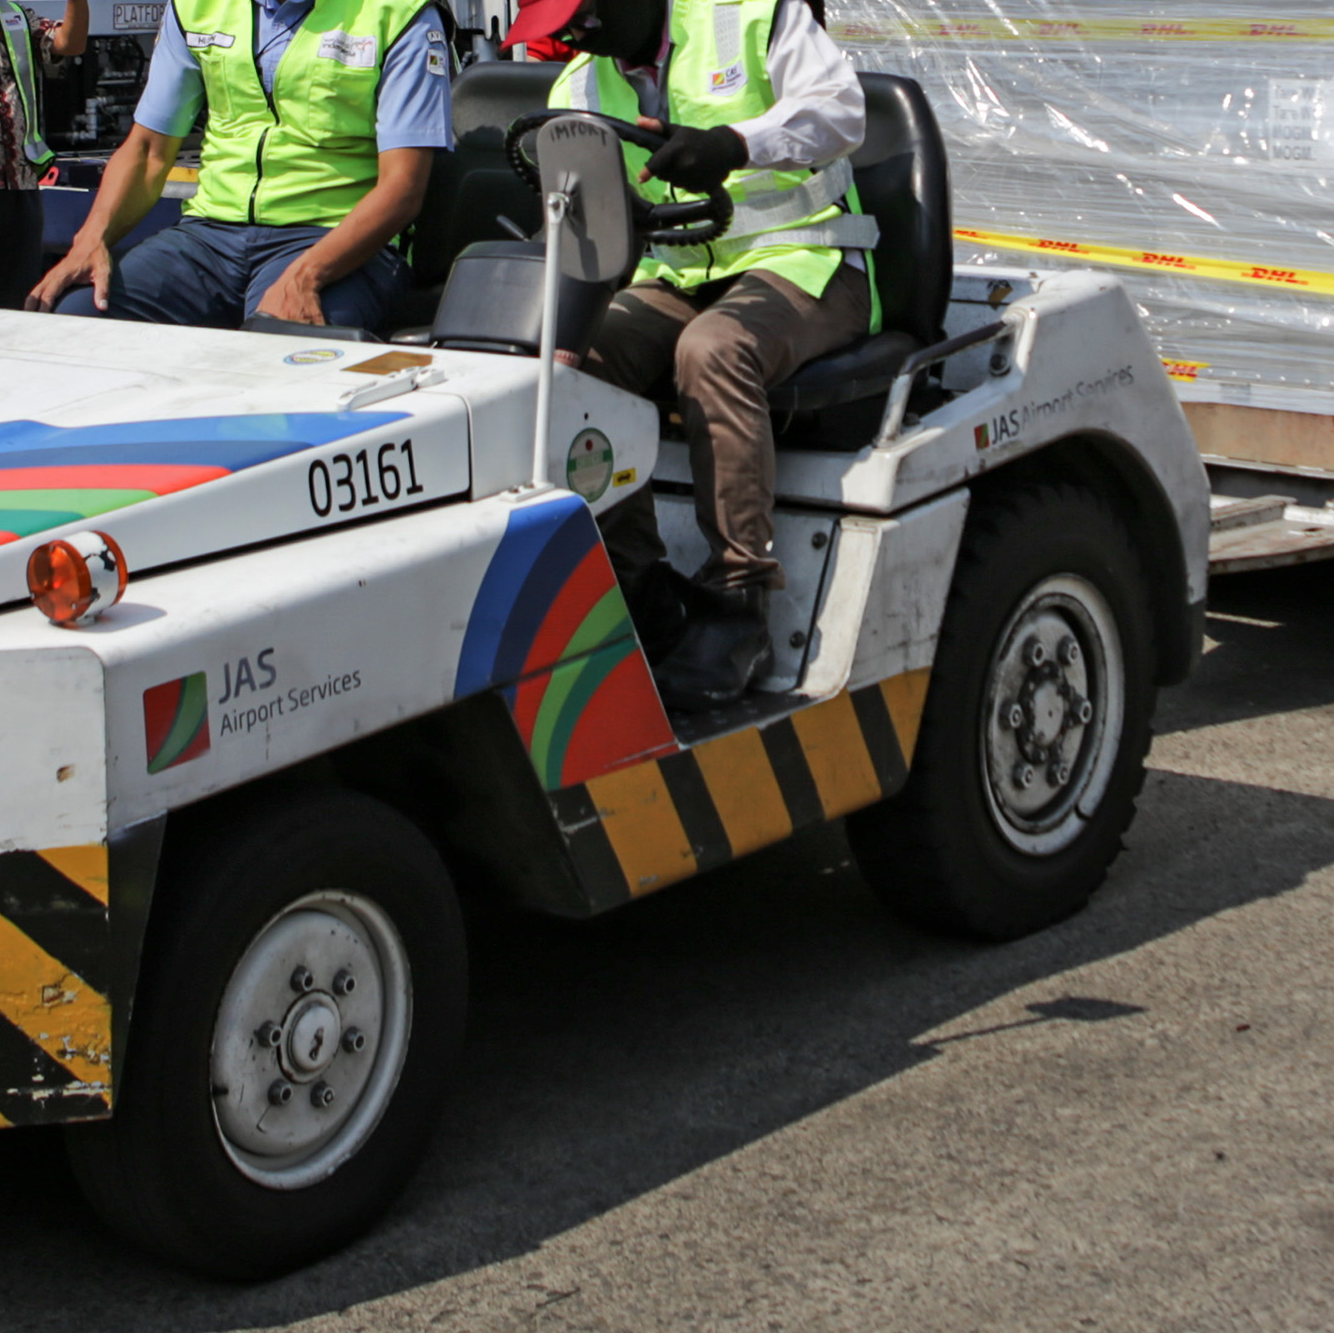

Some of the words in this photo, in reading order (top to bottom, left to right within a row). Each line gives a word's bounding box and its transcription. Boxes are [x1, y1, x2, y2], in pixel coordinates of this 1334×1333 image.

[116, 4, 165, 23] PLATFOR
[550, 120, 608, 147] IMPORT
[1038, 239, 1079, 253] DHL
[1142, 252, 1186, 267] DHL
[1251, 267, 1297, 284] DHL
[991, 410, 1020, 444] JAS
[307, 439, 424, 518] 03161
[218, 647, 277, 705] JAS
[220, 695, 284, 737] Airport
[288, 669, 362, 712] Services
